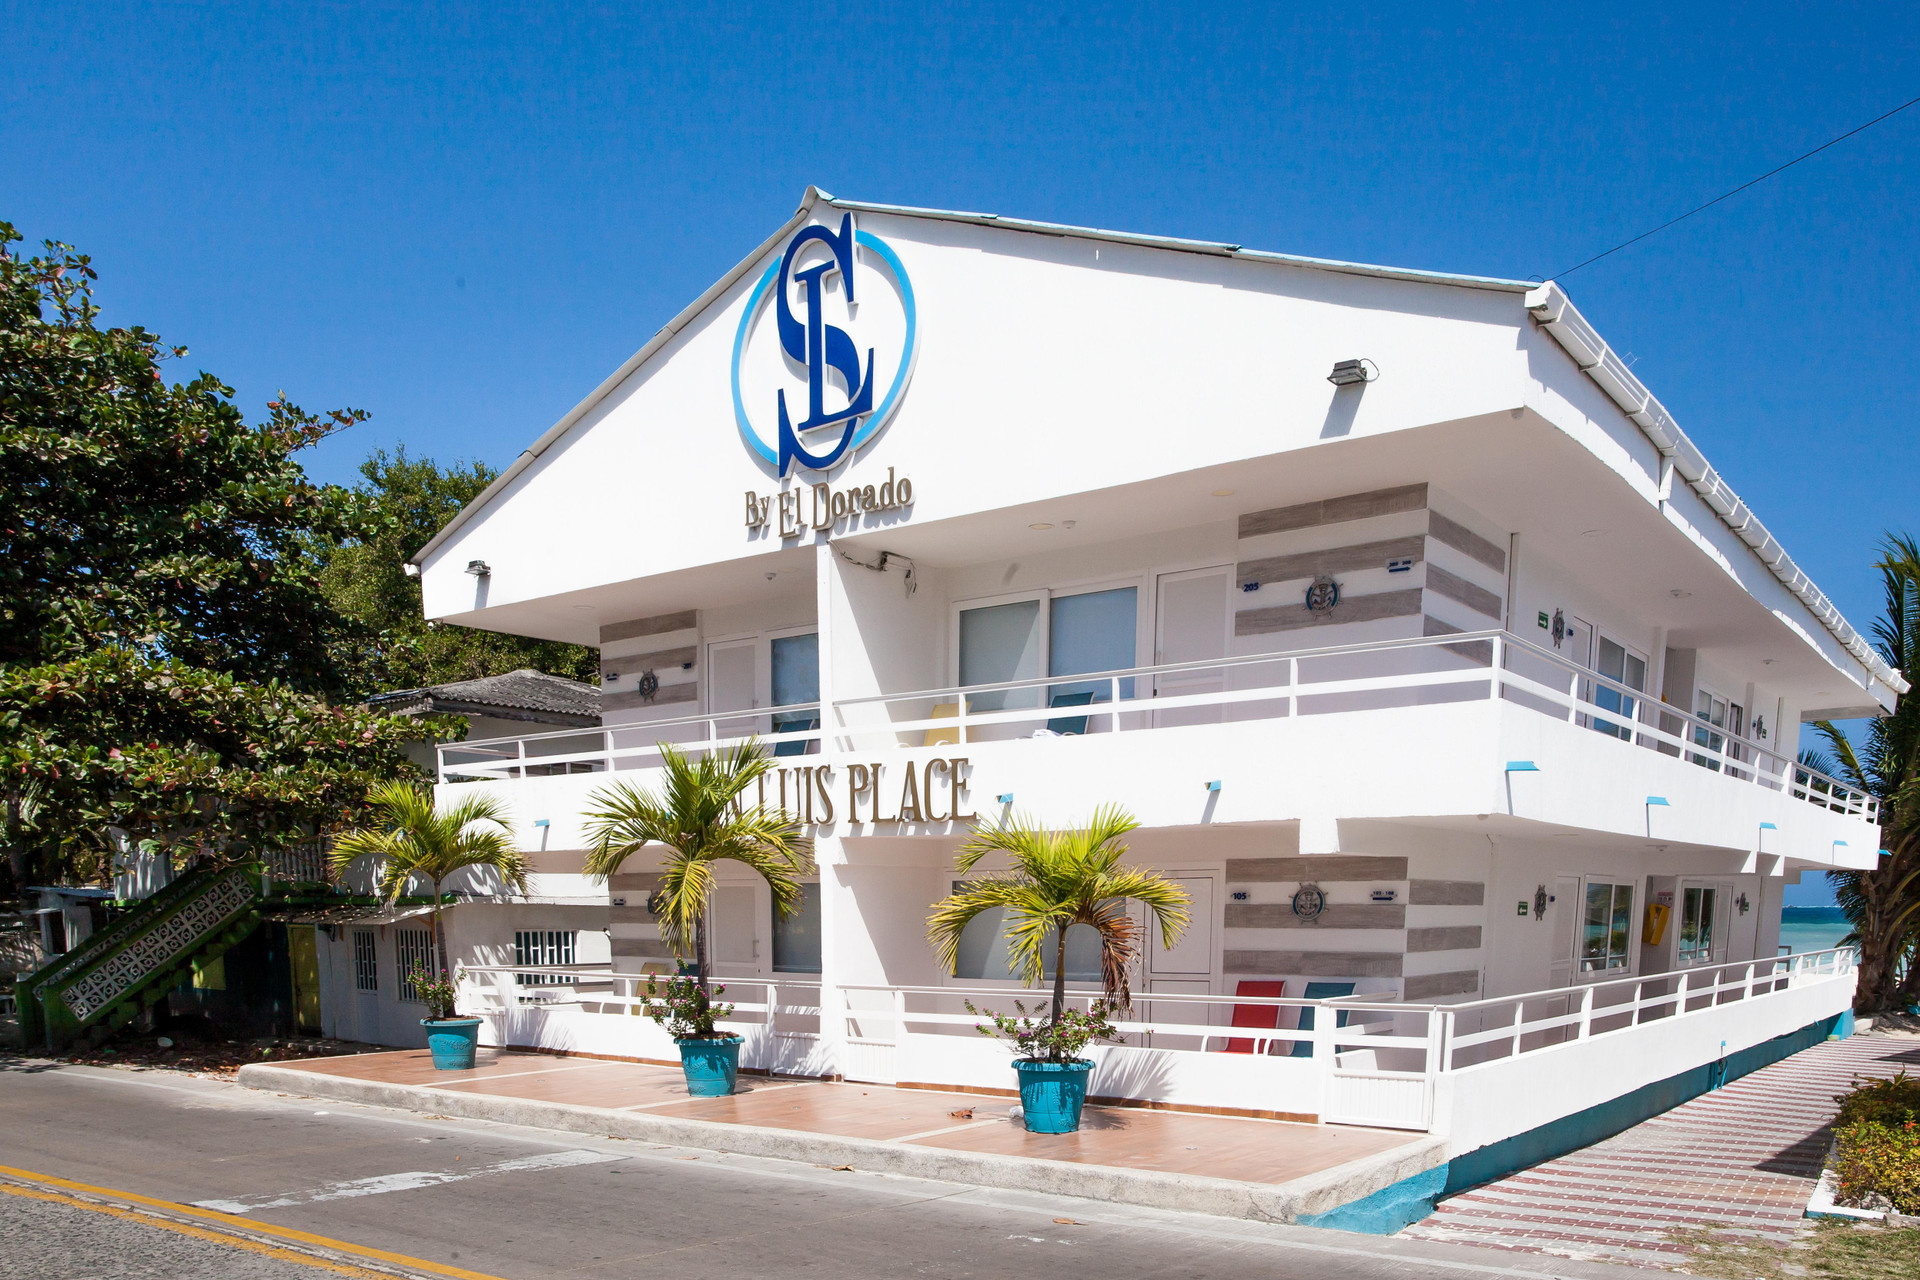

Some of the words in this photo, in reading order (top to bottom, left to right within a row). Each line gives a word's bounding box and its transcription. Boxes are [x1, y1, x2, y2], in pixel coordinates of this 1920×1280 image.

[744, 490, 770, 527] By
[777, 487, 803, 538] El
[811, 466, 912, 530] Dorado
[1243, 582, 1260, 593] 205
[757, 764, 834, 825] LUIS
[847, 757, 978, 823] PLACE
[1232, 892, 1247, 900] 105
